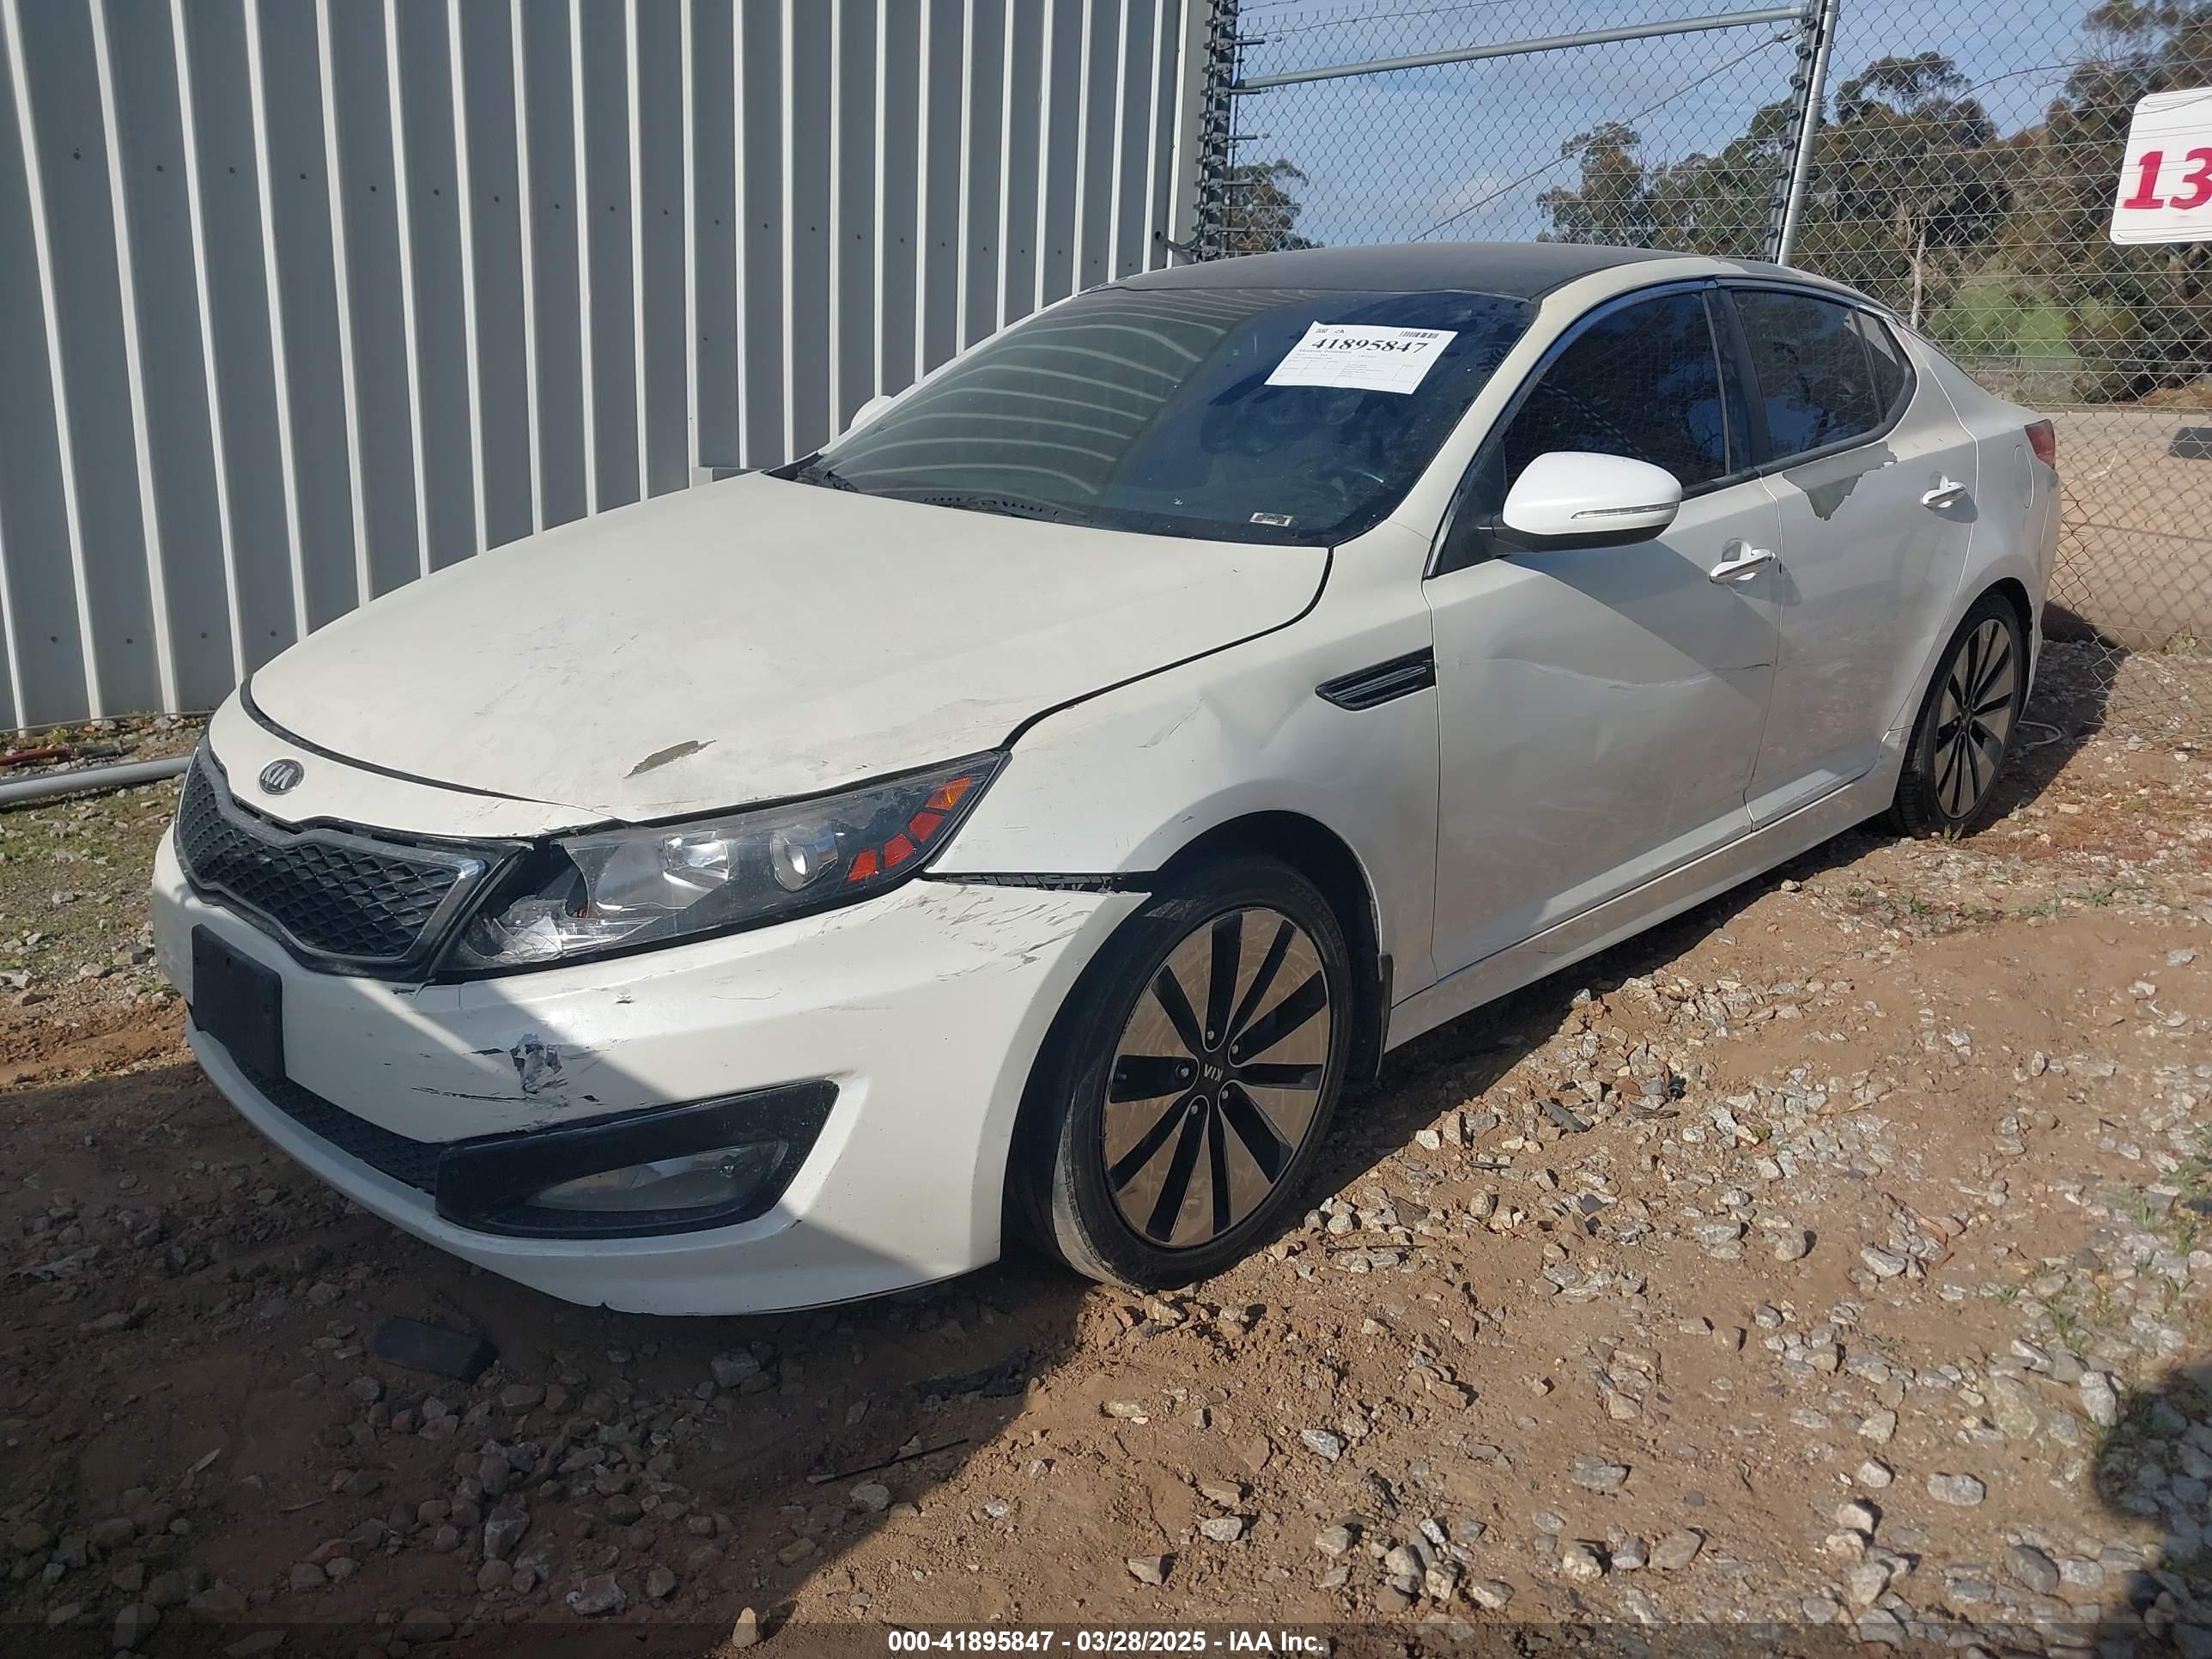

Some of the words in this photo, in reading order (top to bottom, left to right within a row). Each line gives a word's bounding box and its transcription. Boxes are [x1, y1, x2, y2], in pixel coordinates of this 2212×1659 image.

[2123, 147, 2212, 210] 13
[1312, 337, 1430, 354] 41895847
[261, 762, 295, 790] KIA
[1203, 1062, 1224, 1083] KIA
